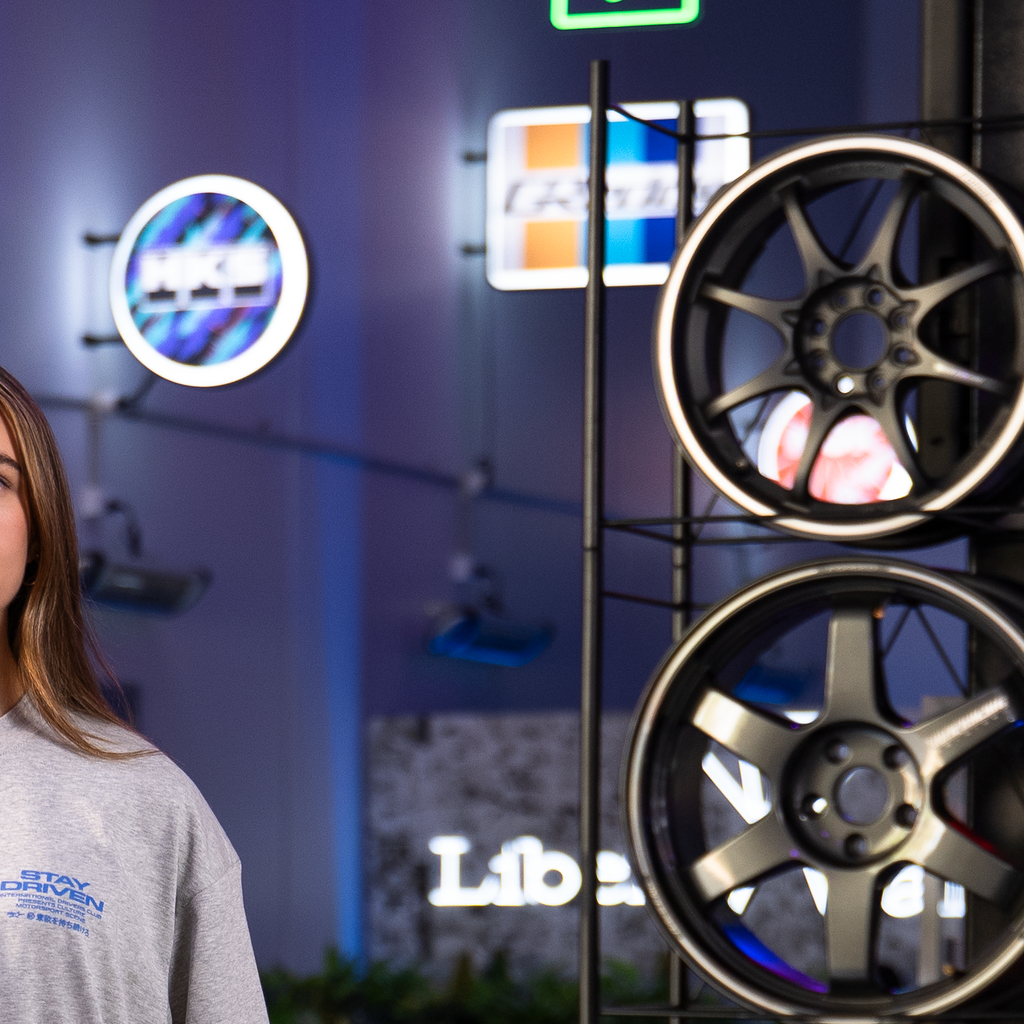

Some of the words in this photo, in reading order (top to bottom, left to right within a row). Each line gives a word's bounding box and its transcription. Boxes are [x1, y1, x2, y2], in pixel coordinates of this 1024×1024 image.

[20, 870, 91, 890] STAY
[0, 881, 104, 912] DRIVEN
[0, 892, 56, 903] INTERNATIONAL
[57, 898, 86, 912] DRIVERS
[86, 908, 102, 920] CLUB
[17, 897, 56, 908] PRESENTS
[57, 903, 86, 917] CULTURE
[16, 903, 64, 915] MOTORSPORT
[65, 912, 86, 924] SCENE
